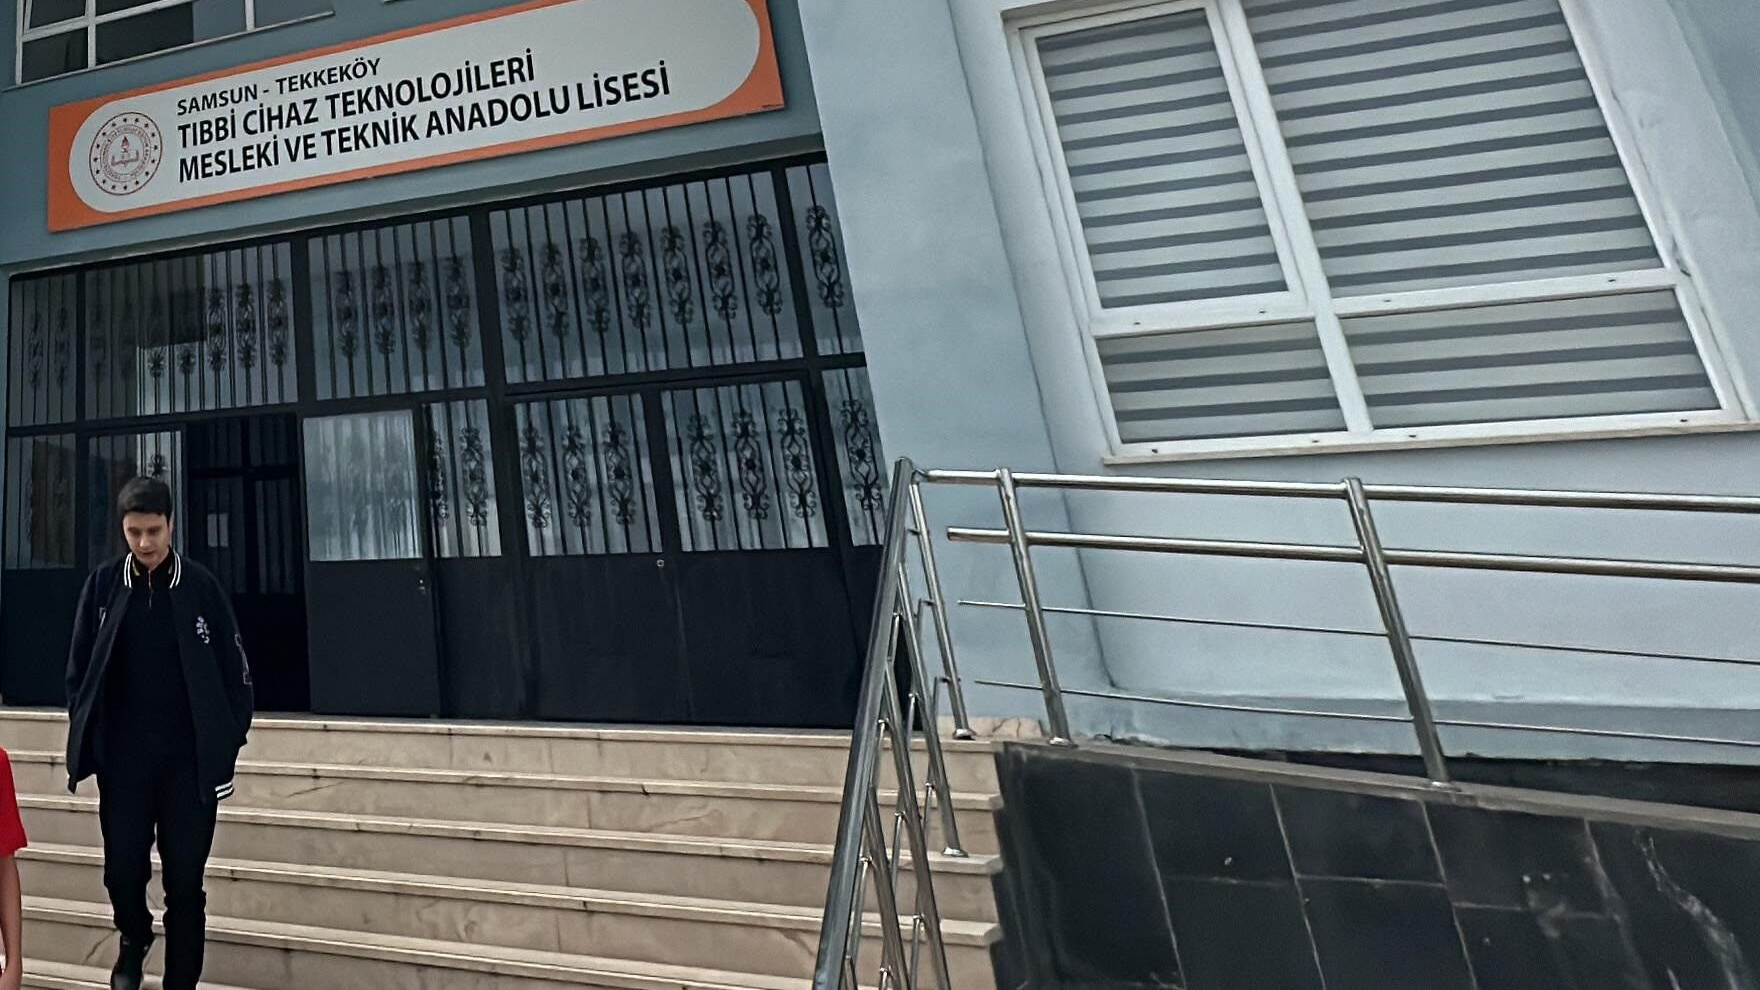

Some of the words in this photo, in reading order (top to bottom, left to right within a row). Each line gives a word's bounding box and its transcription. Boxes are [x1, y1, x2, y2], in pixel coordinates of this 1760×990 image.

[177, 83, 258, 116] SAMSUN
[275, 57, 381, 95] TEKKEKÖY
[177, 108, 236, 149] TIBBİ
[242, 97, 319, 136] CİHAZ
[324, 47, 535, 120] TEKNOLOJİLERİ
[179, 134, 279, 183] MESLEKİ
[284, 133, 317, 163] VE
[320, 111, 420, 156] TEKNİK
[425, 85, 570, 139] ANADOLU
[576, 59, 670, 111] LİSESİ
